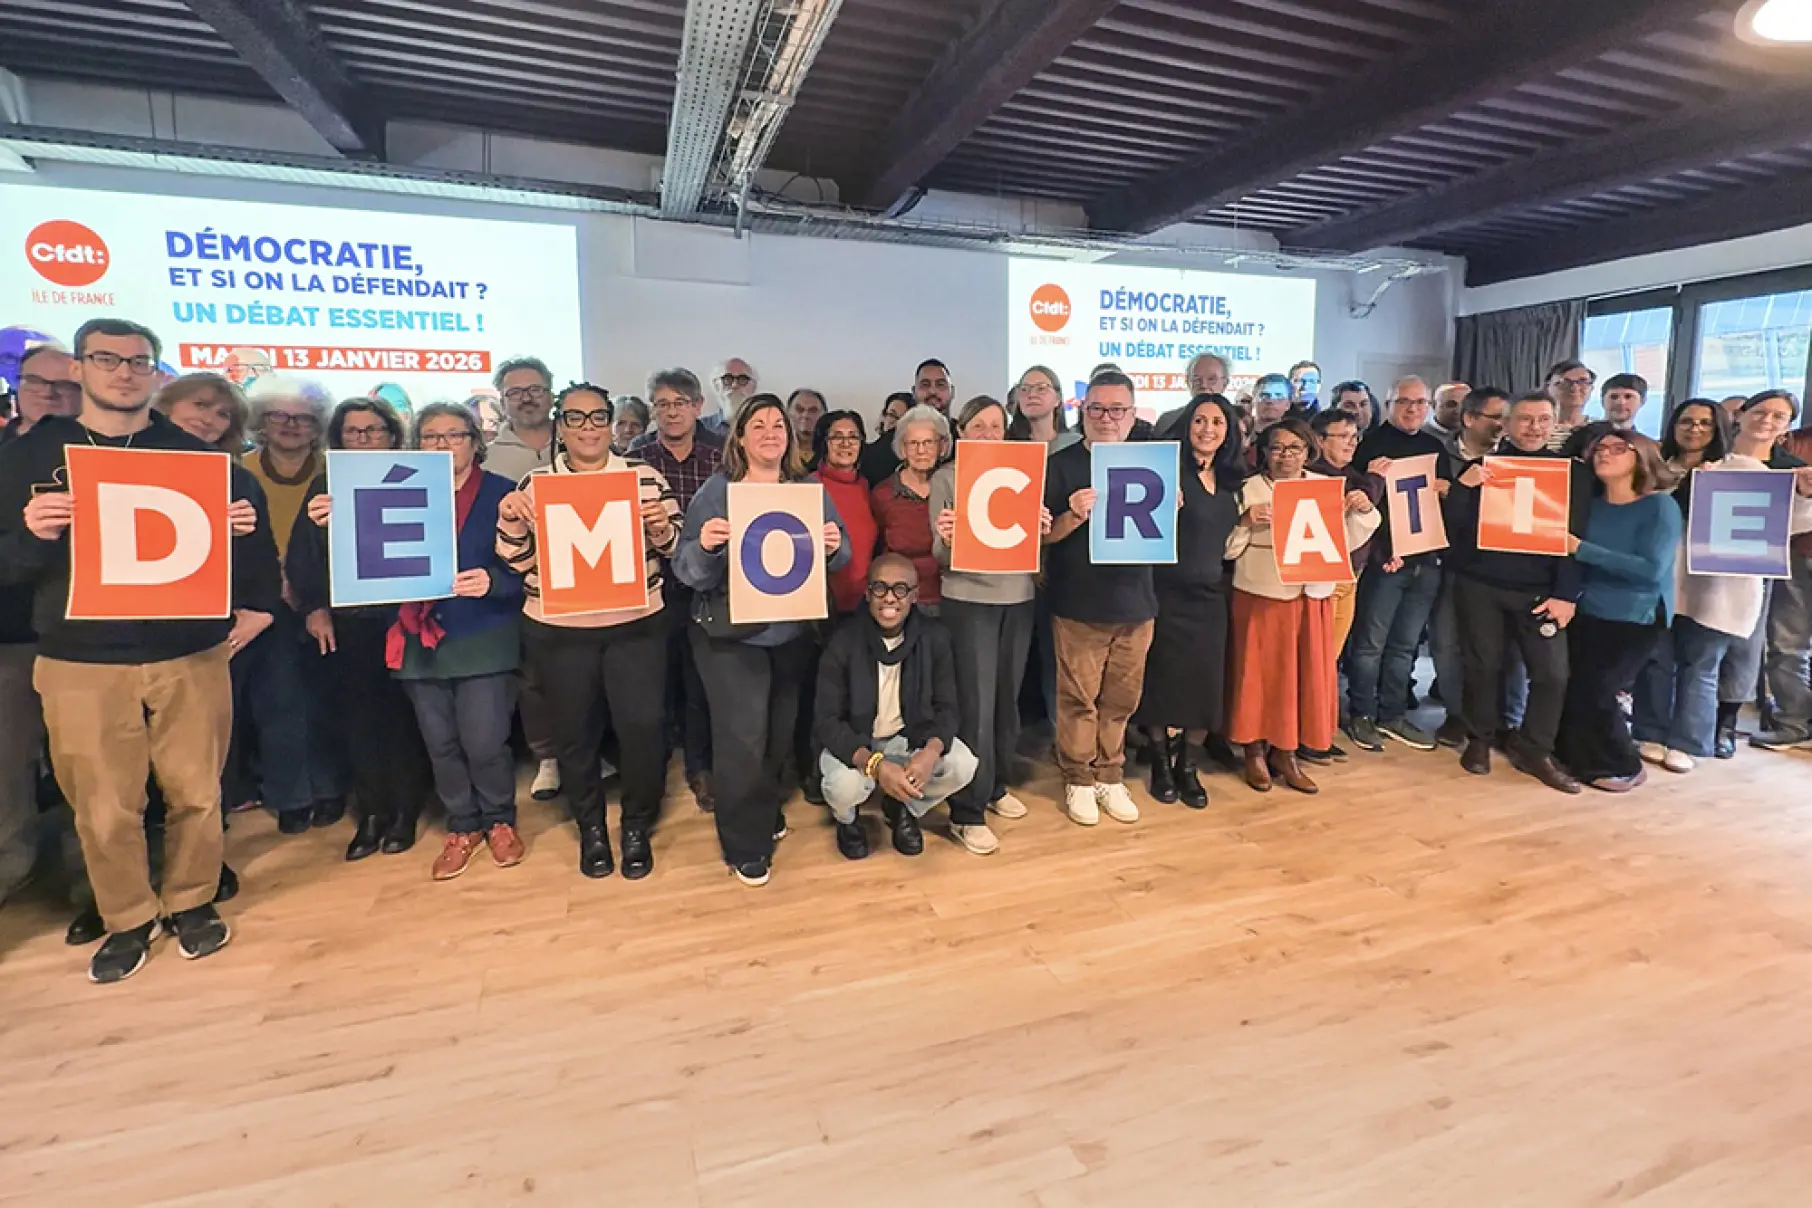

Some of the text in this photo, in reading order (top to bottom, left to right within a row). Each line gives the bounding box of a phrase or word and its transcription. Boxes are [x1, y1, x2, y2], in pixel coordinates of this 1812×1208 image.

[165, 226, 424, 276] DÉMOCRATIE,
[70, 291, 116, 306] FRANCE
[168, 266, 488, 300] ET SI ON LA DÉFENDAIT ?
[1100, 286, 1232, 319] DÉMOCRATIE,
[172, 300, 485, 333] UN DÉBAT ESSENTIEL !
[1100, 316, 1265, 336] ET SI ON LA DÉFENDAIT ?
[191, 346, 483, 371] MAI 13 JANVIER 2026
[1099, 342, 1121, 358] UN
[1126, 340, 1175, 359] DÉBAT
[1255, 347, 1261, 361] !
[1153, 375, 1166, 389] 13
[354, 463, 431, 580] É
[967, 467, 1031, 549] C
[1105, 467, 1165, 540] R
[1283, 499, 1343, 564] A
[1396, 475, 1428, 534] T
[1513, 477, 1535, 534] I
[1709, 492, 1771, 555] E
[98, 483, 212, 585] D
[545, 500, 636, 590] M
[741, 511, 814, 595] O
